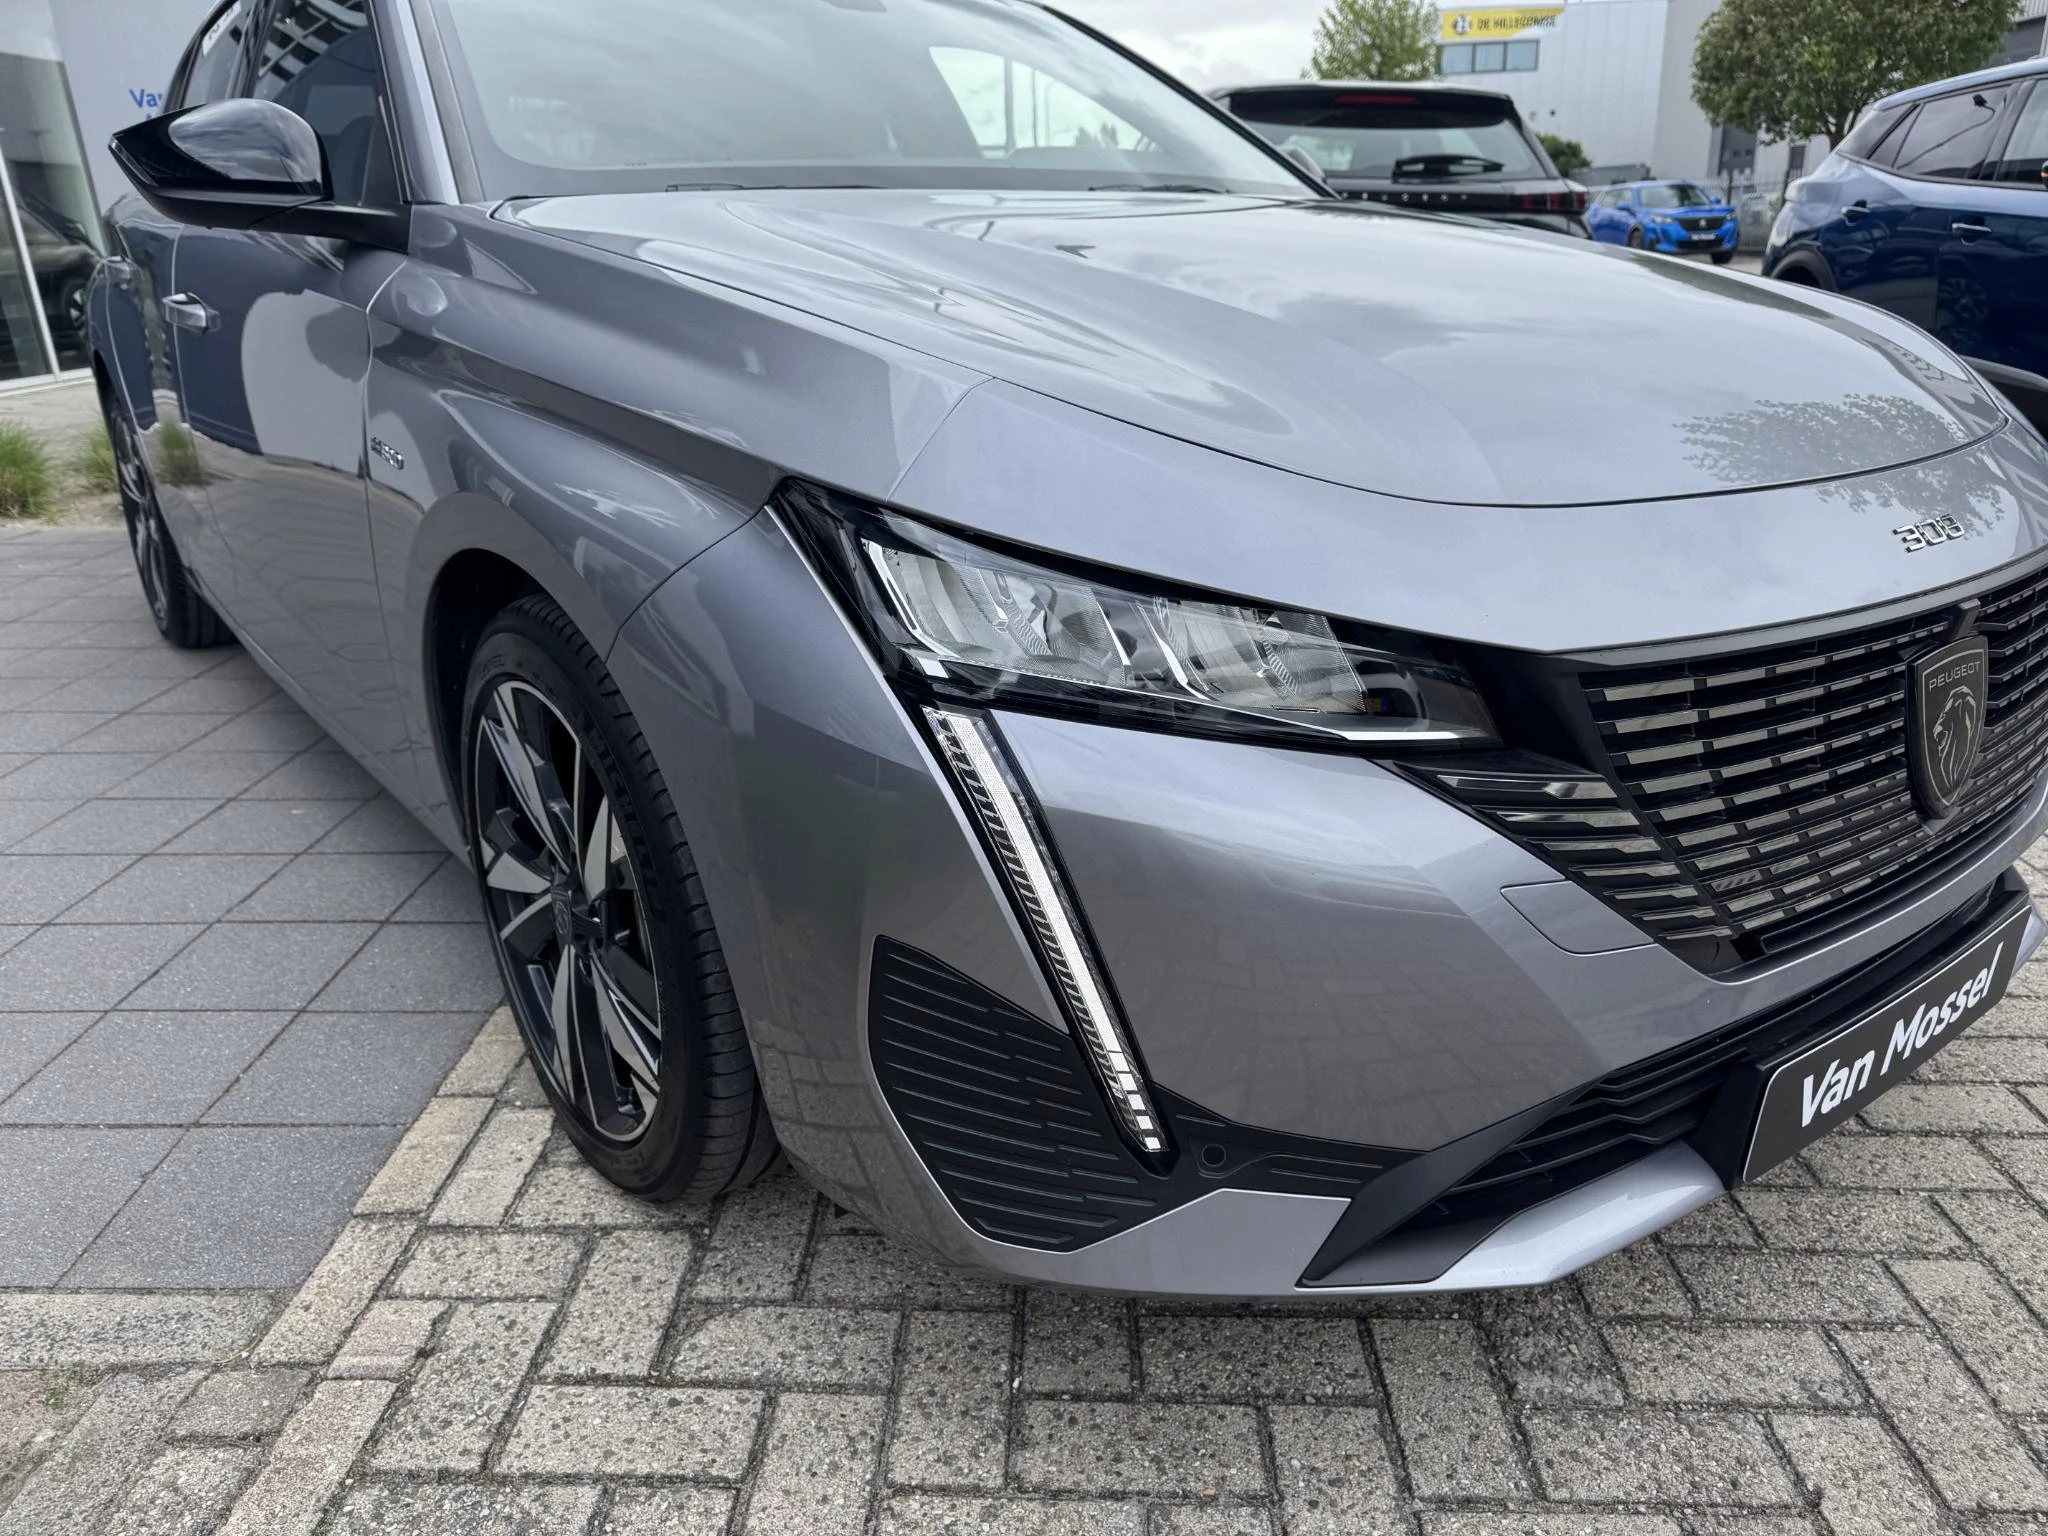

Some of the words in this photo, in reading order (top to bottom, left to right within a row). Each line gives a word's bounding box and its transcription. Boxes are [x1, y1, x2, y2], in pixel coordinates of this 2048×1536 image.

[1892, 513, 1965, 553] 308
[1929, 661, 1981, 693] PEUGEOT
[1802, 1050, 1875, 1128] Van
[1880, 941, 2004, 1076] Mossel
